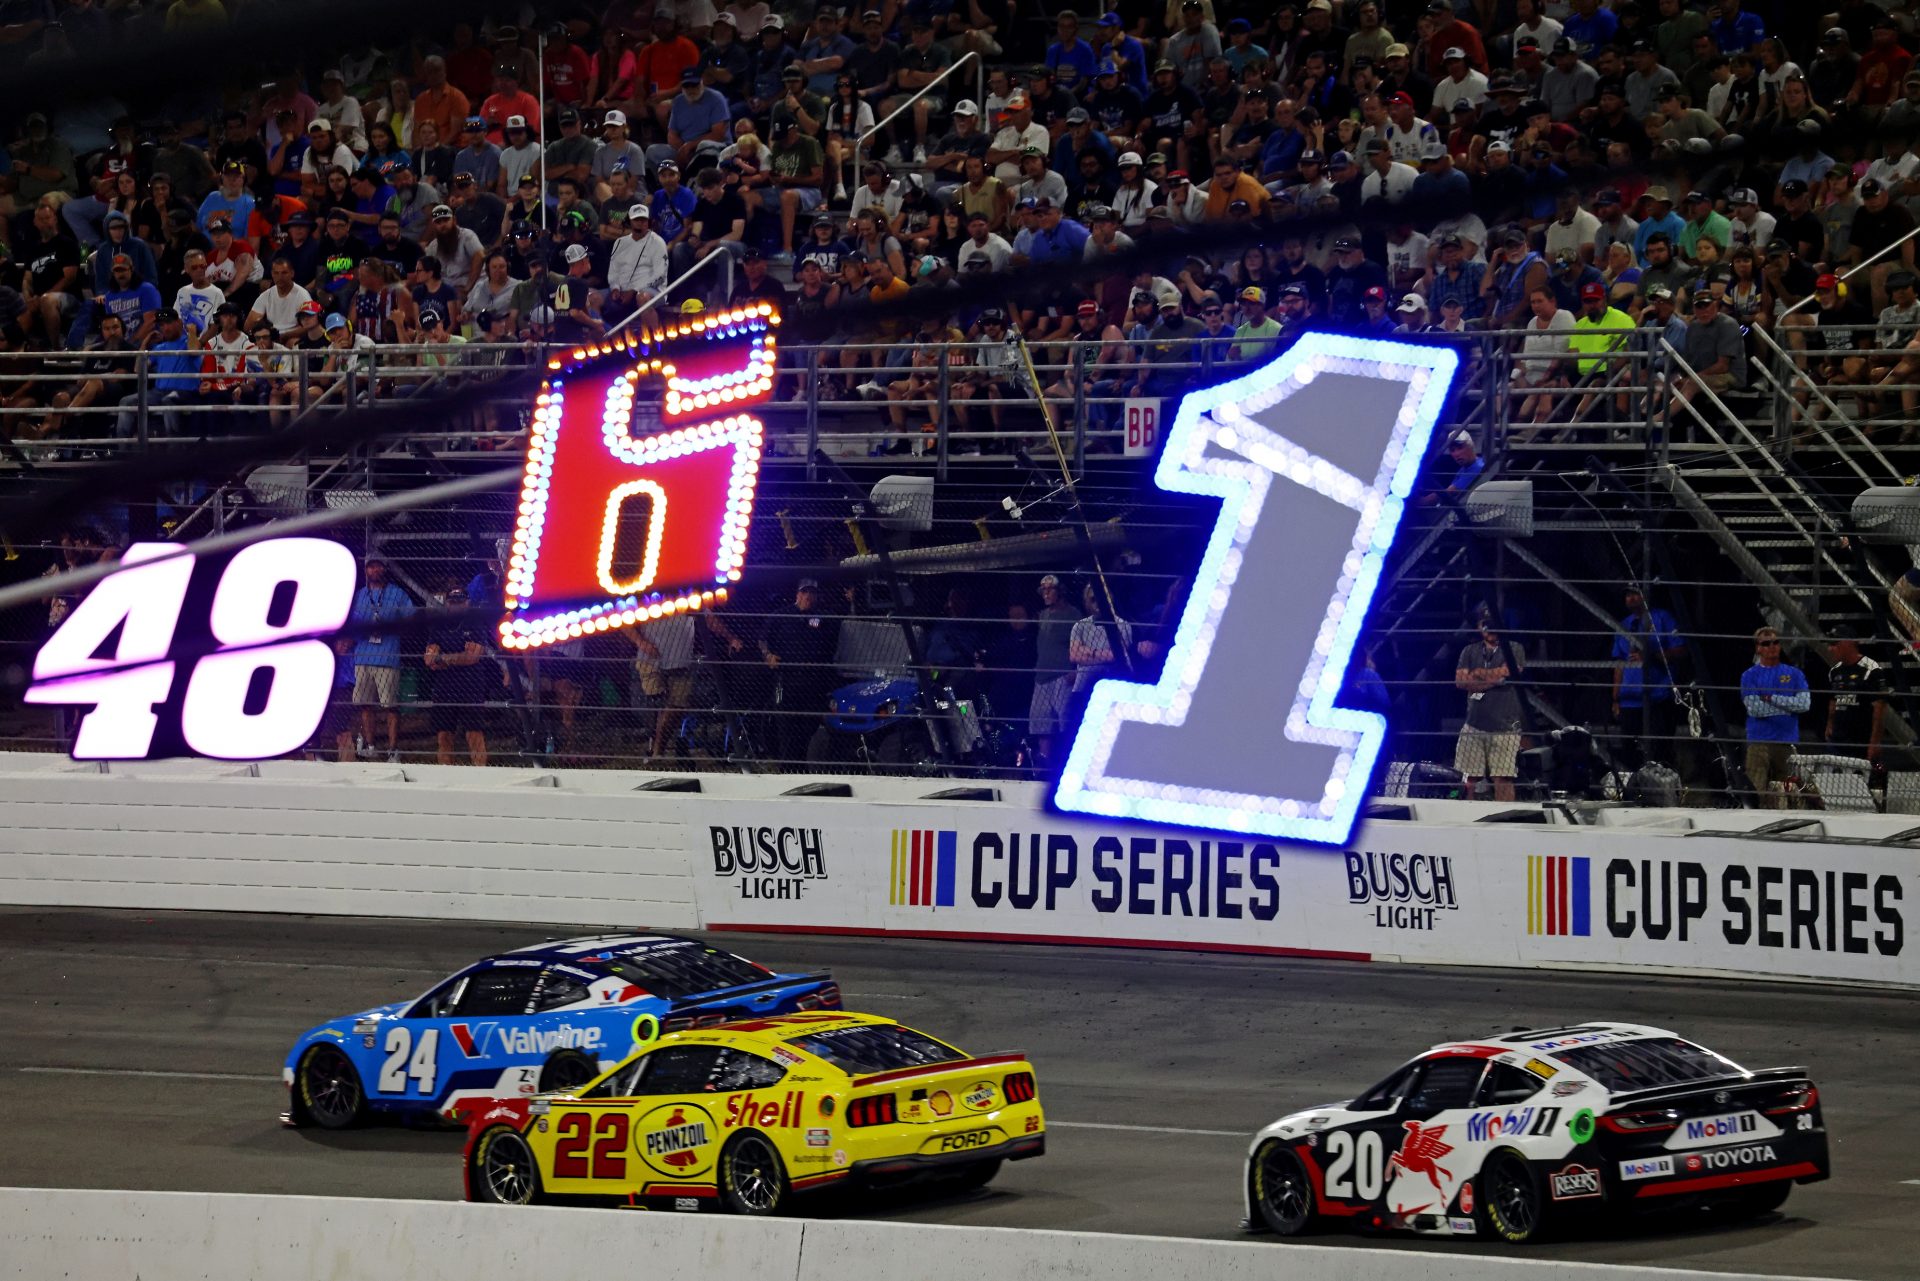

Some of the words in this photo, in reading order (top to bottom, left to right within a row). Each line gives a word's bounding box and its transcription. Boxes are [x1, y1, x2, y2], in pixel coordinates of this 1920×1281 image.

[1128, 407, 1155, 448] BB
[1054, 331, 1459, 847] 1
[23, 536, 358, 760] 48
[709, 826, 828, 879] BUSCH
[741, 877, 805, 900] LIGHT
[971, 831, 1078, 911] CUP
[1091, 836, 1281, 921] SERIES
[1344, 851, 1459, 909] BUSCH
[1376, 905, 1436, 931] LIGHT
[1605, 858, 1708, 942] CUP
[1722, 864, 1904, 957] SERIES
[377, 1026, 440, 1094] 24
[724, 1090, 805, 1129] Shell
[1466, 1106, 1535, 1142] Mobil
[1686, 1116, 1738, 1140] Mobil
[1796, 1114, 1813, 1132] 20
[553, 1112, 629, 1180] 22
[646, 1121, 711, 1156] PENNZOIL
[941, 1130, 991, 1152] FORD
[1704, 1145, 1778, 1169] TOYOTA
[1324, 1130, 1384, 1201] 20
[1624, 1162, 1658, 1176] Mobil
